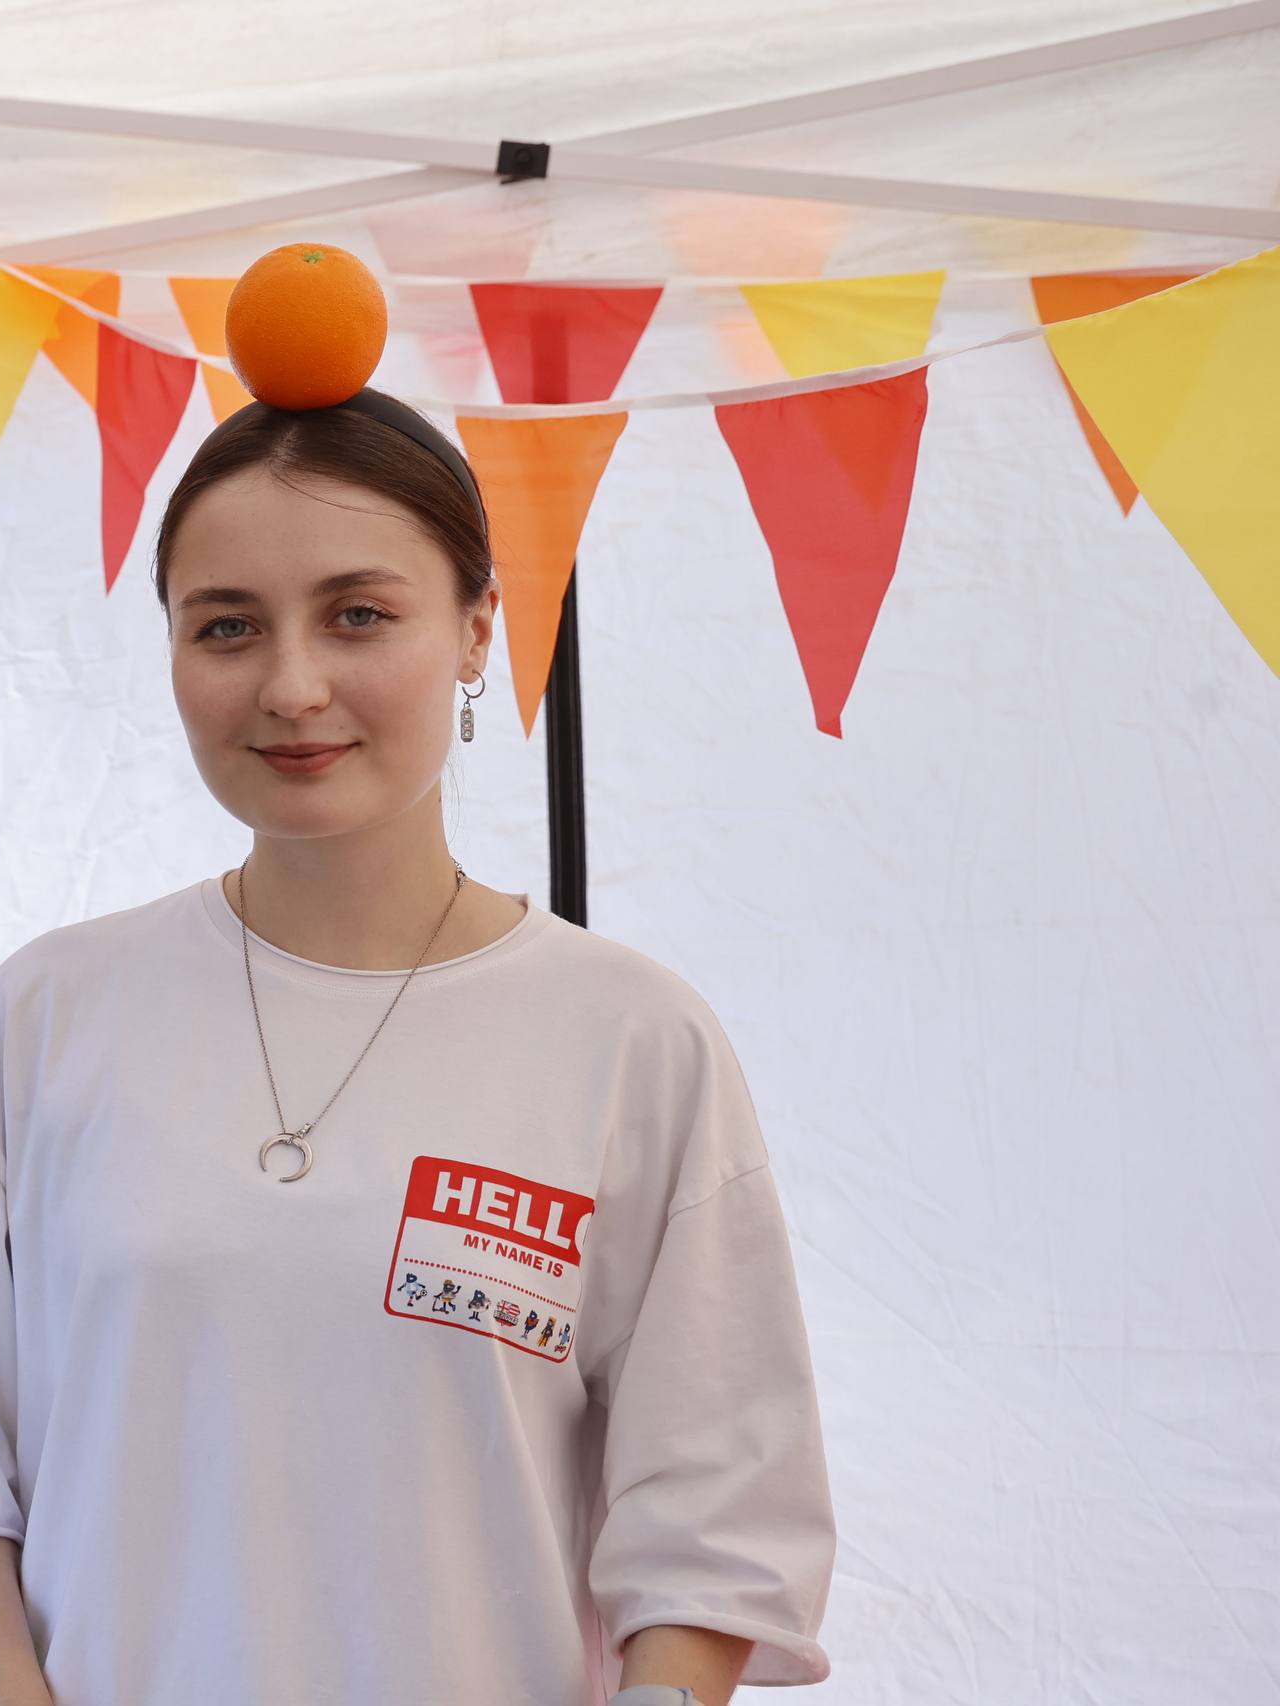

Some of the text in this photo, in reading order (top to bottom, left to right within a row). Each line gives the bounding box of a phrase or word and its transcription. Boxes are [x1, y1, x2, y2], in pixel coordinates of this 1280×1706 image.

[463, 1234, 564, 1278] MY NAME IS
